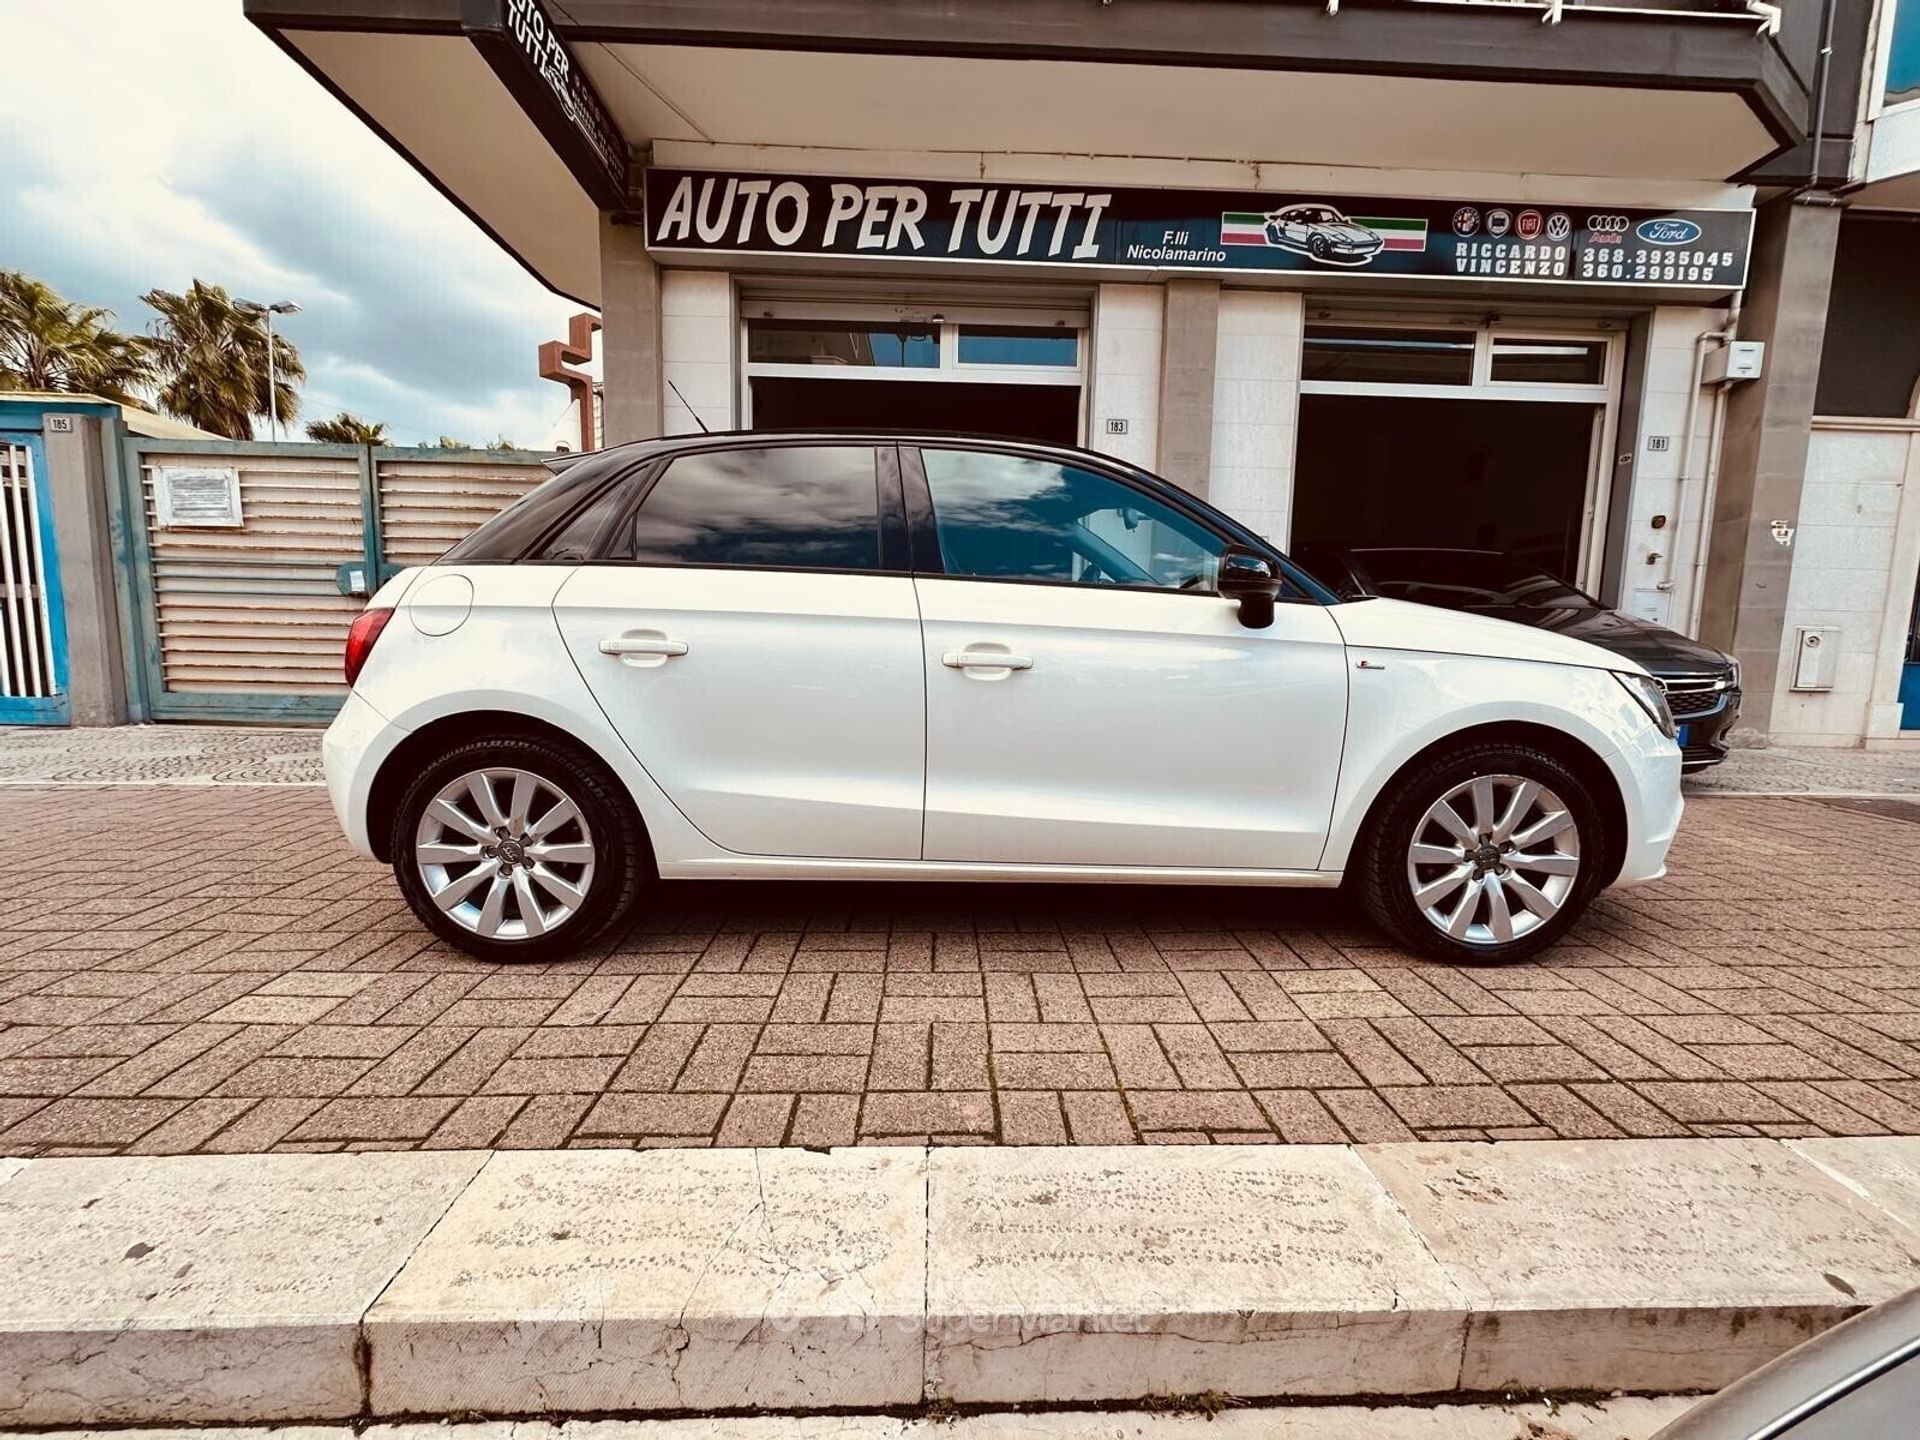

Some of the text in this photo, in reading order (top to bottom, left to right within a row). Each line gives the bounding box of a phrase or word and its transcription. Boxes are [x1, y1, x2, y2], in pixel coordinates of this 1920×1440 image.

[508, 0, 548, 78] TUTTI
[546, 28, 569, 83] PER
[656, 176, 1112, 260] AUTO PER TUTTI
[1649, 222, 1689, 240] Ford
[1127, 244, 1227, 262] Nicolamarino
[1455, 242, 1734, 267] RICCARDO 368.3935045
[1455, 258, 1715, 282] VINCENZO 360.299195
[53, 419, 67, 430] 185
[1111, 421, 1123, 432] 183
[1652, 439, 1665, 449] 181
